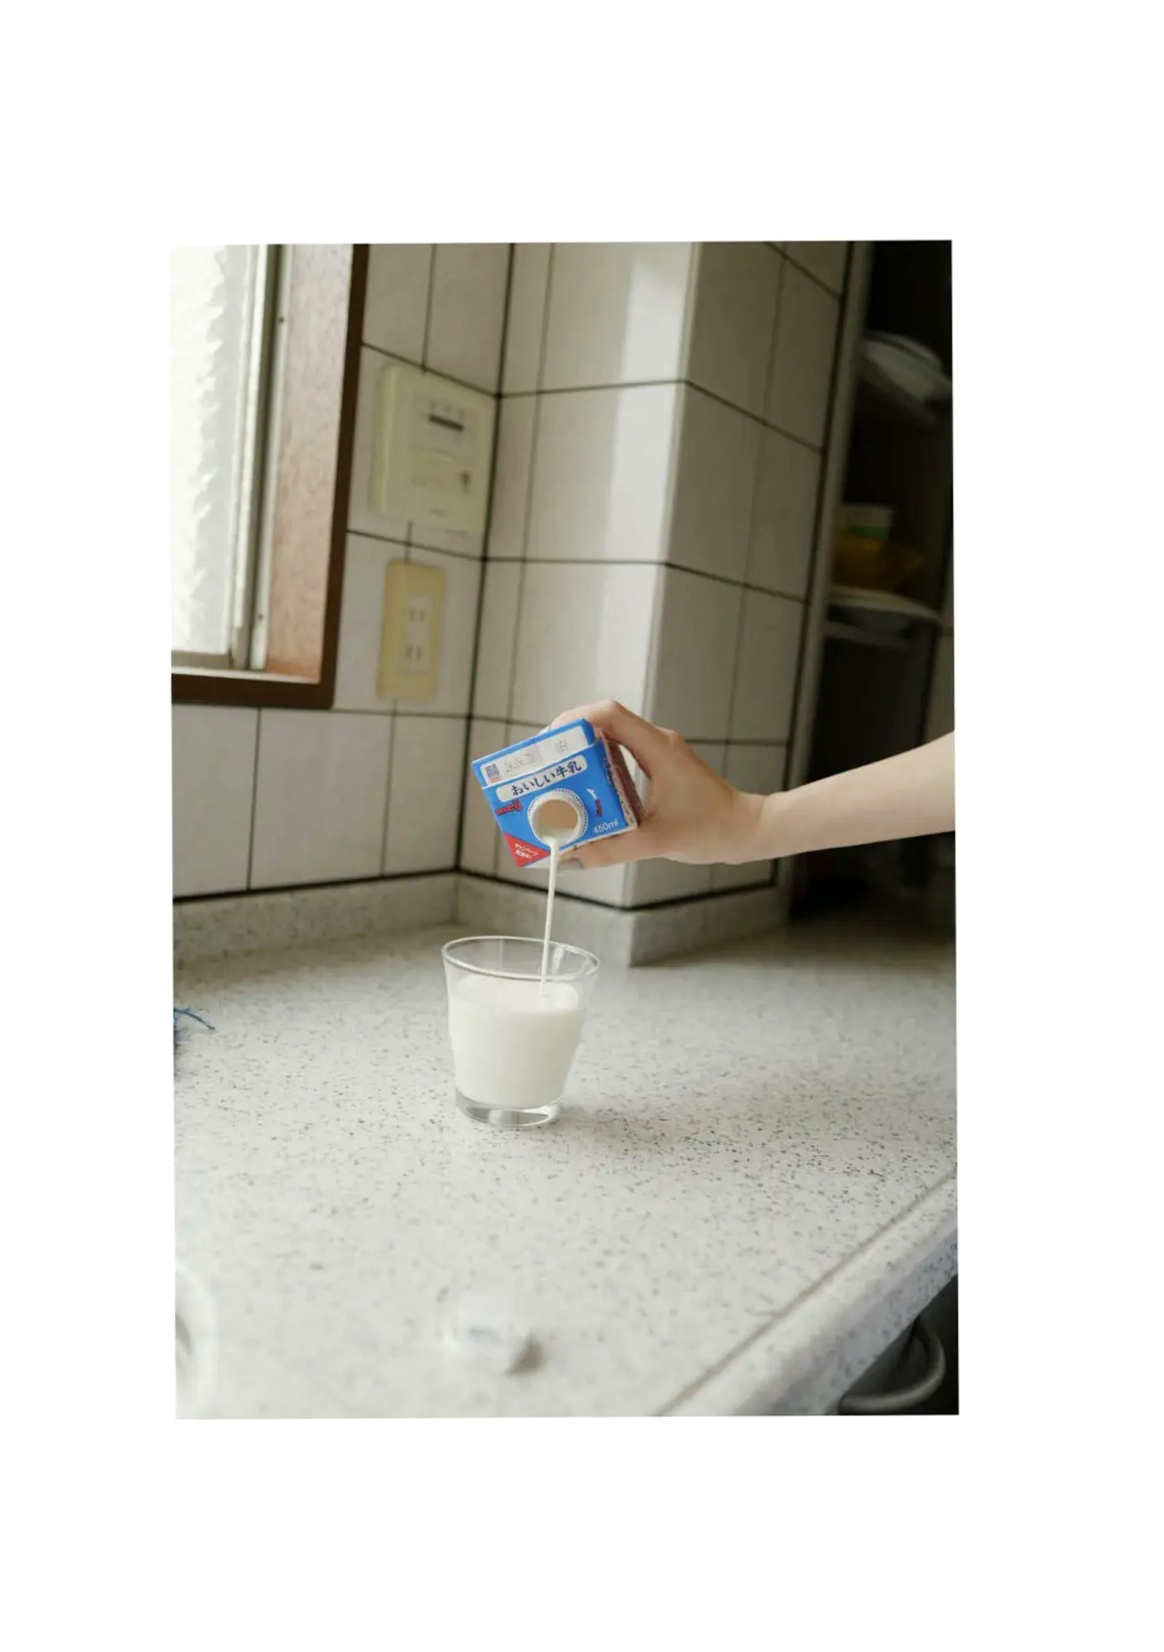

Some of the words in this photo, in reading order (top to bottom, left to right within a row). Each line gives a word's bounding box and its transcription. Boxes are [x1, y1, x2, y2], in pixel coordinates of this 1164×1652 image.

[511, 760, 582, 796] おいしい牛乳
[593, 819, 619, 834] 450ml
